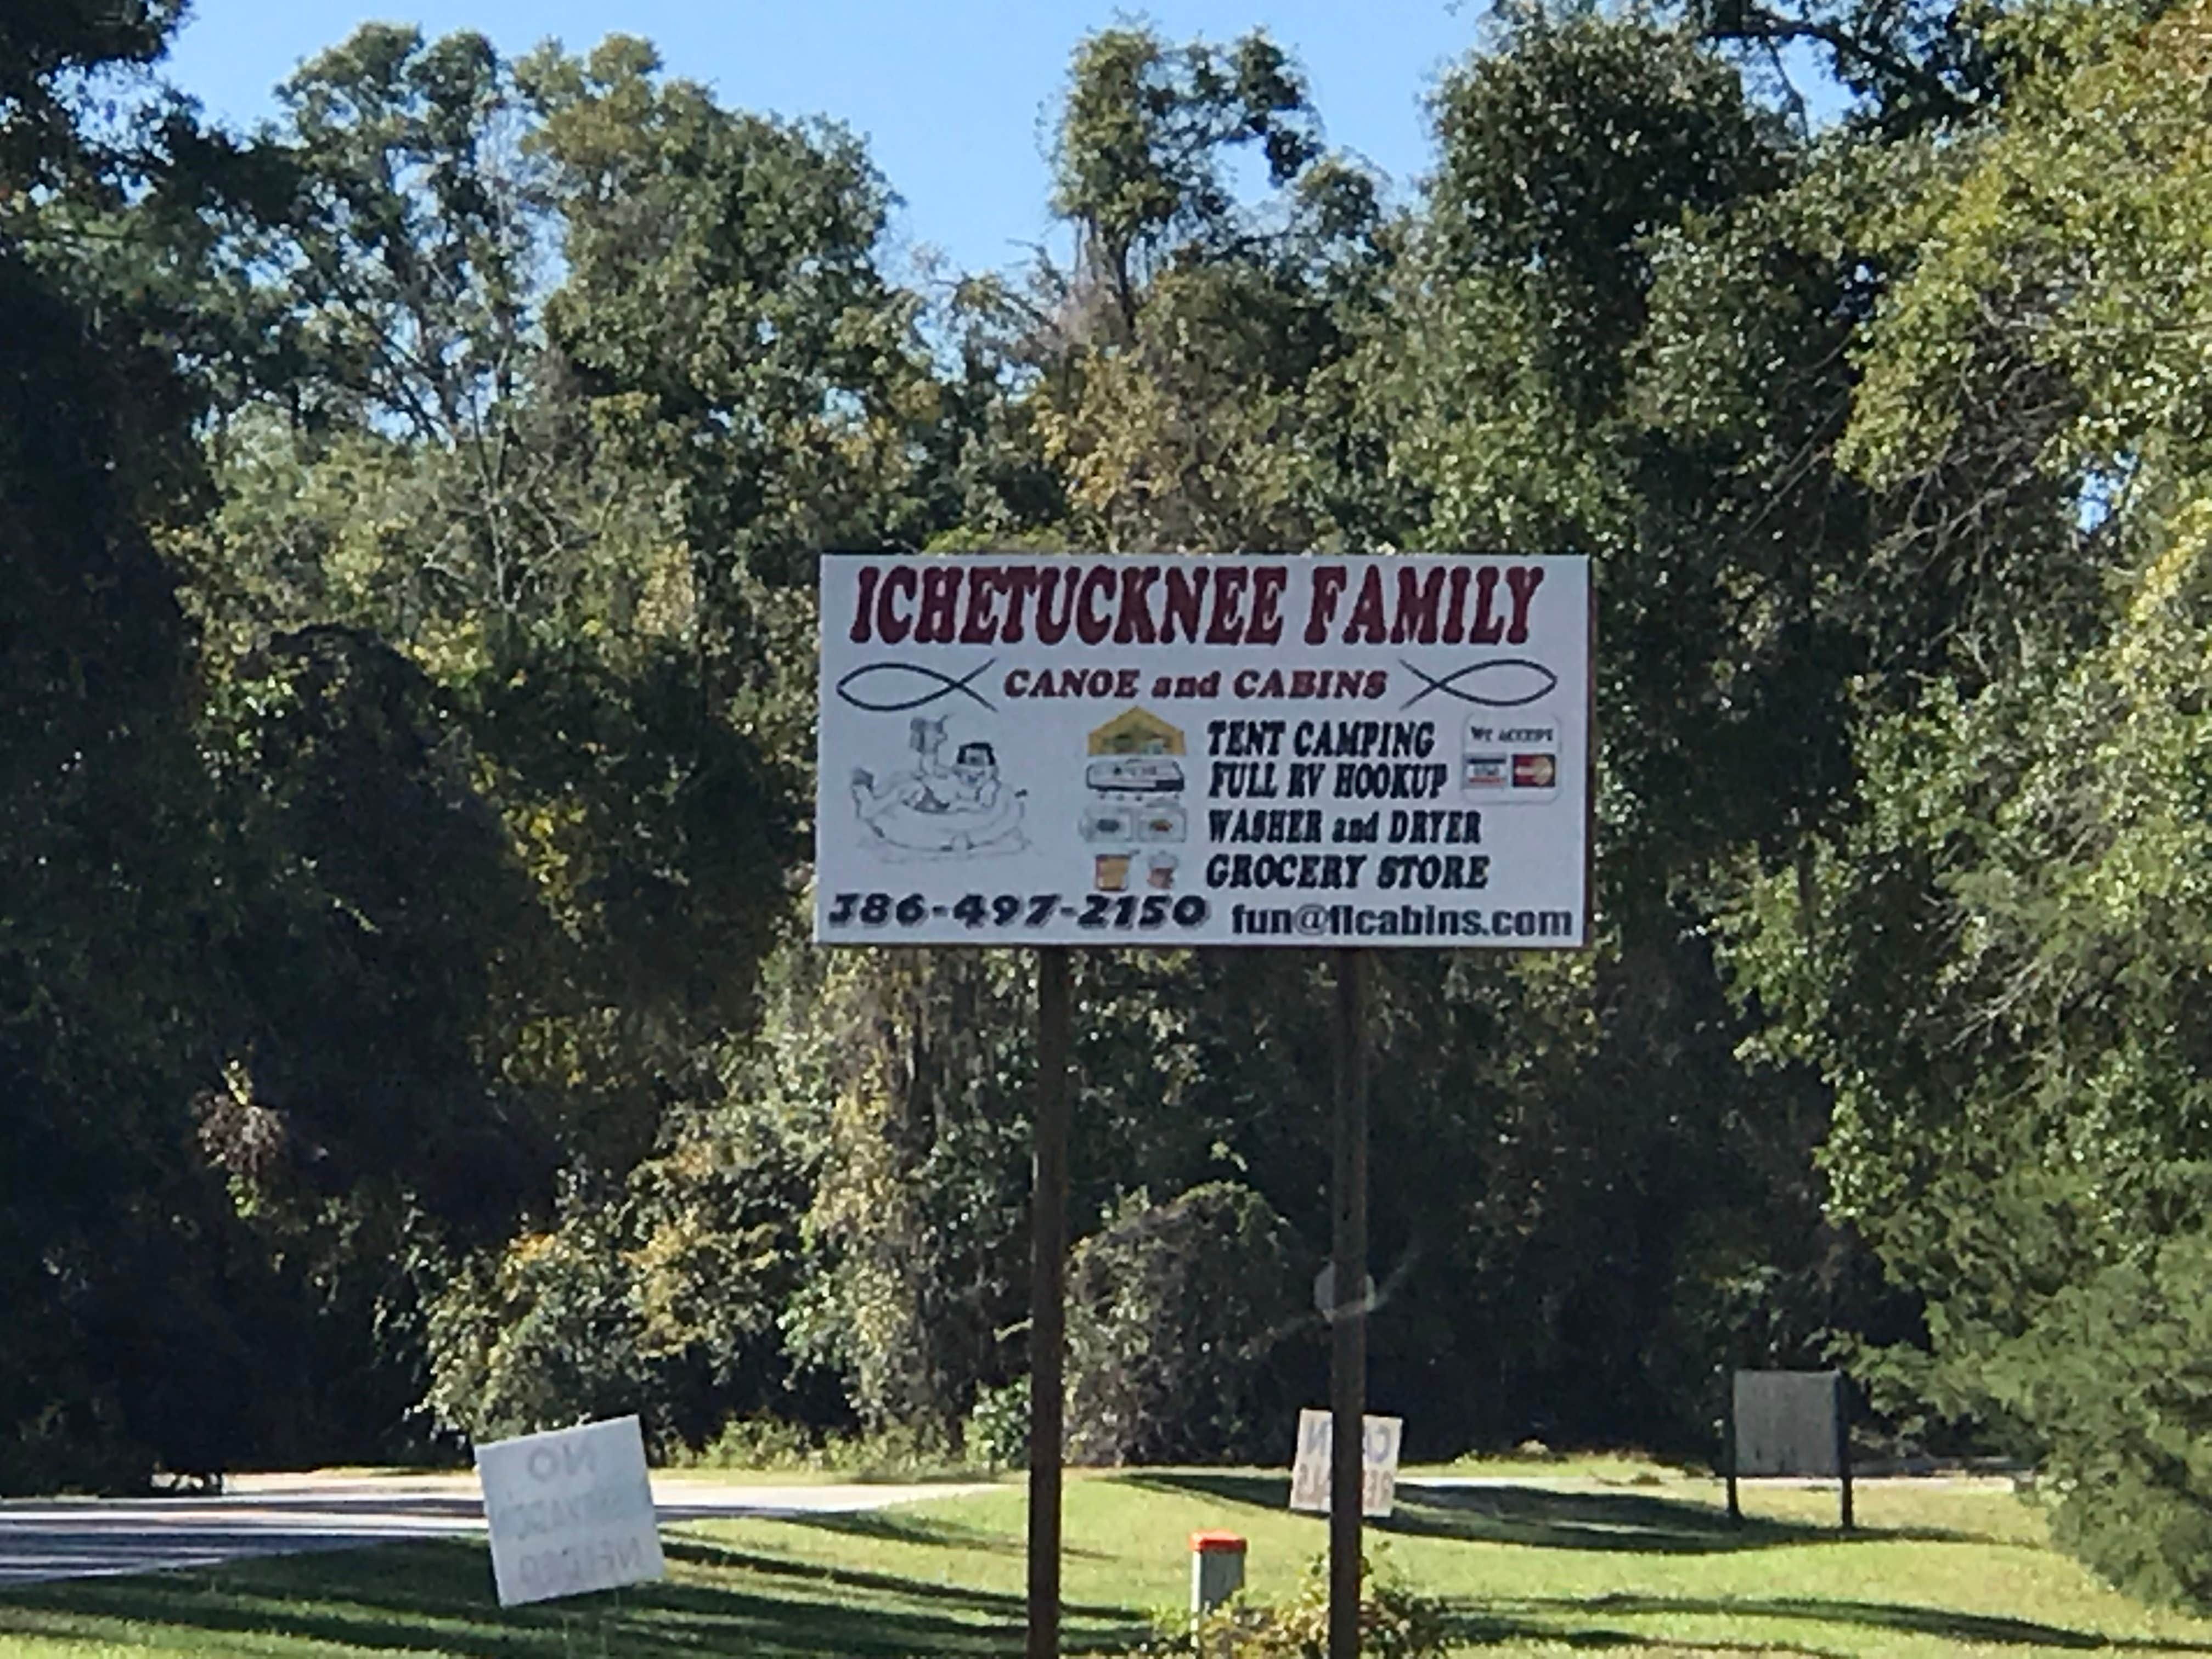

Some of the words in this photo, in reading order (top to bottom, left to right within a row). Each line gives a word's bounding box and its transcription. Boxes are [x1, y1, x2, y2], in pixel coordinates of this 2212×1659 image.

[849, 564, 1288, 646] ICHETUCKNEE
[1304, 563, 1545, 646] FAMILY
[1003, 668, 1141, 699] CANOE
[1151, 670, 1222, 699] and
[1233, 668, 1389, 700] CABINS
[1207, 720, 1285, 758] TENT
[1293, 720, 1435, 759] CAMPING
[1208, 760, 1278, 799] FULL
[1286, 763, 1326, 798] RV
[1333, 763, 1447, 799] HOOKUP
[1209, 808, 1322, 844] WASHER
[1331, 810, 1380, 844] and
[1387, 809, 1481, 844] DRYER
[1206, 853, 1368, 890] GROCERY
[1376, 854, 1490, 890] STORE
[828, 893, 1210, 930] 386-497-2150
